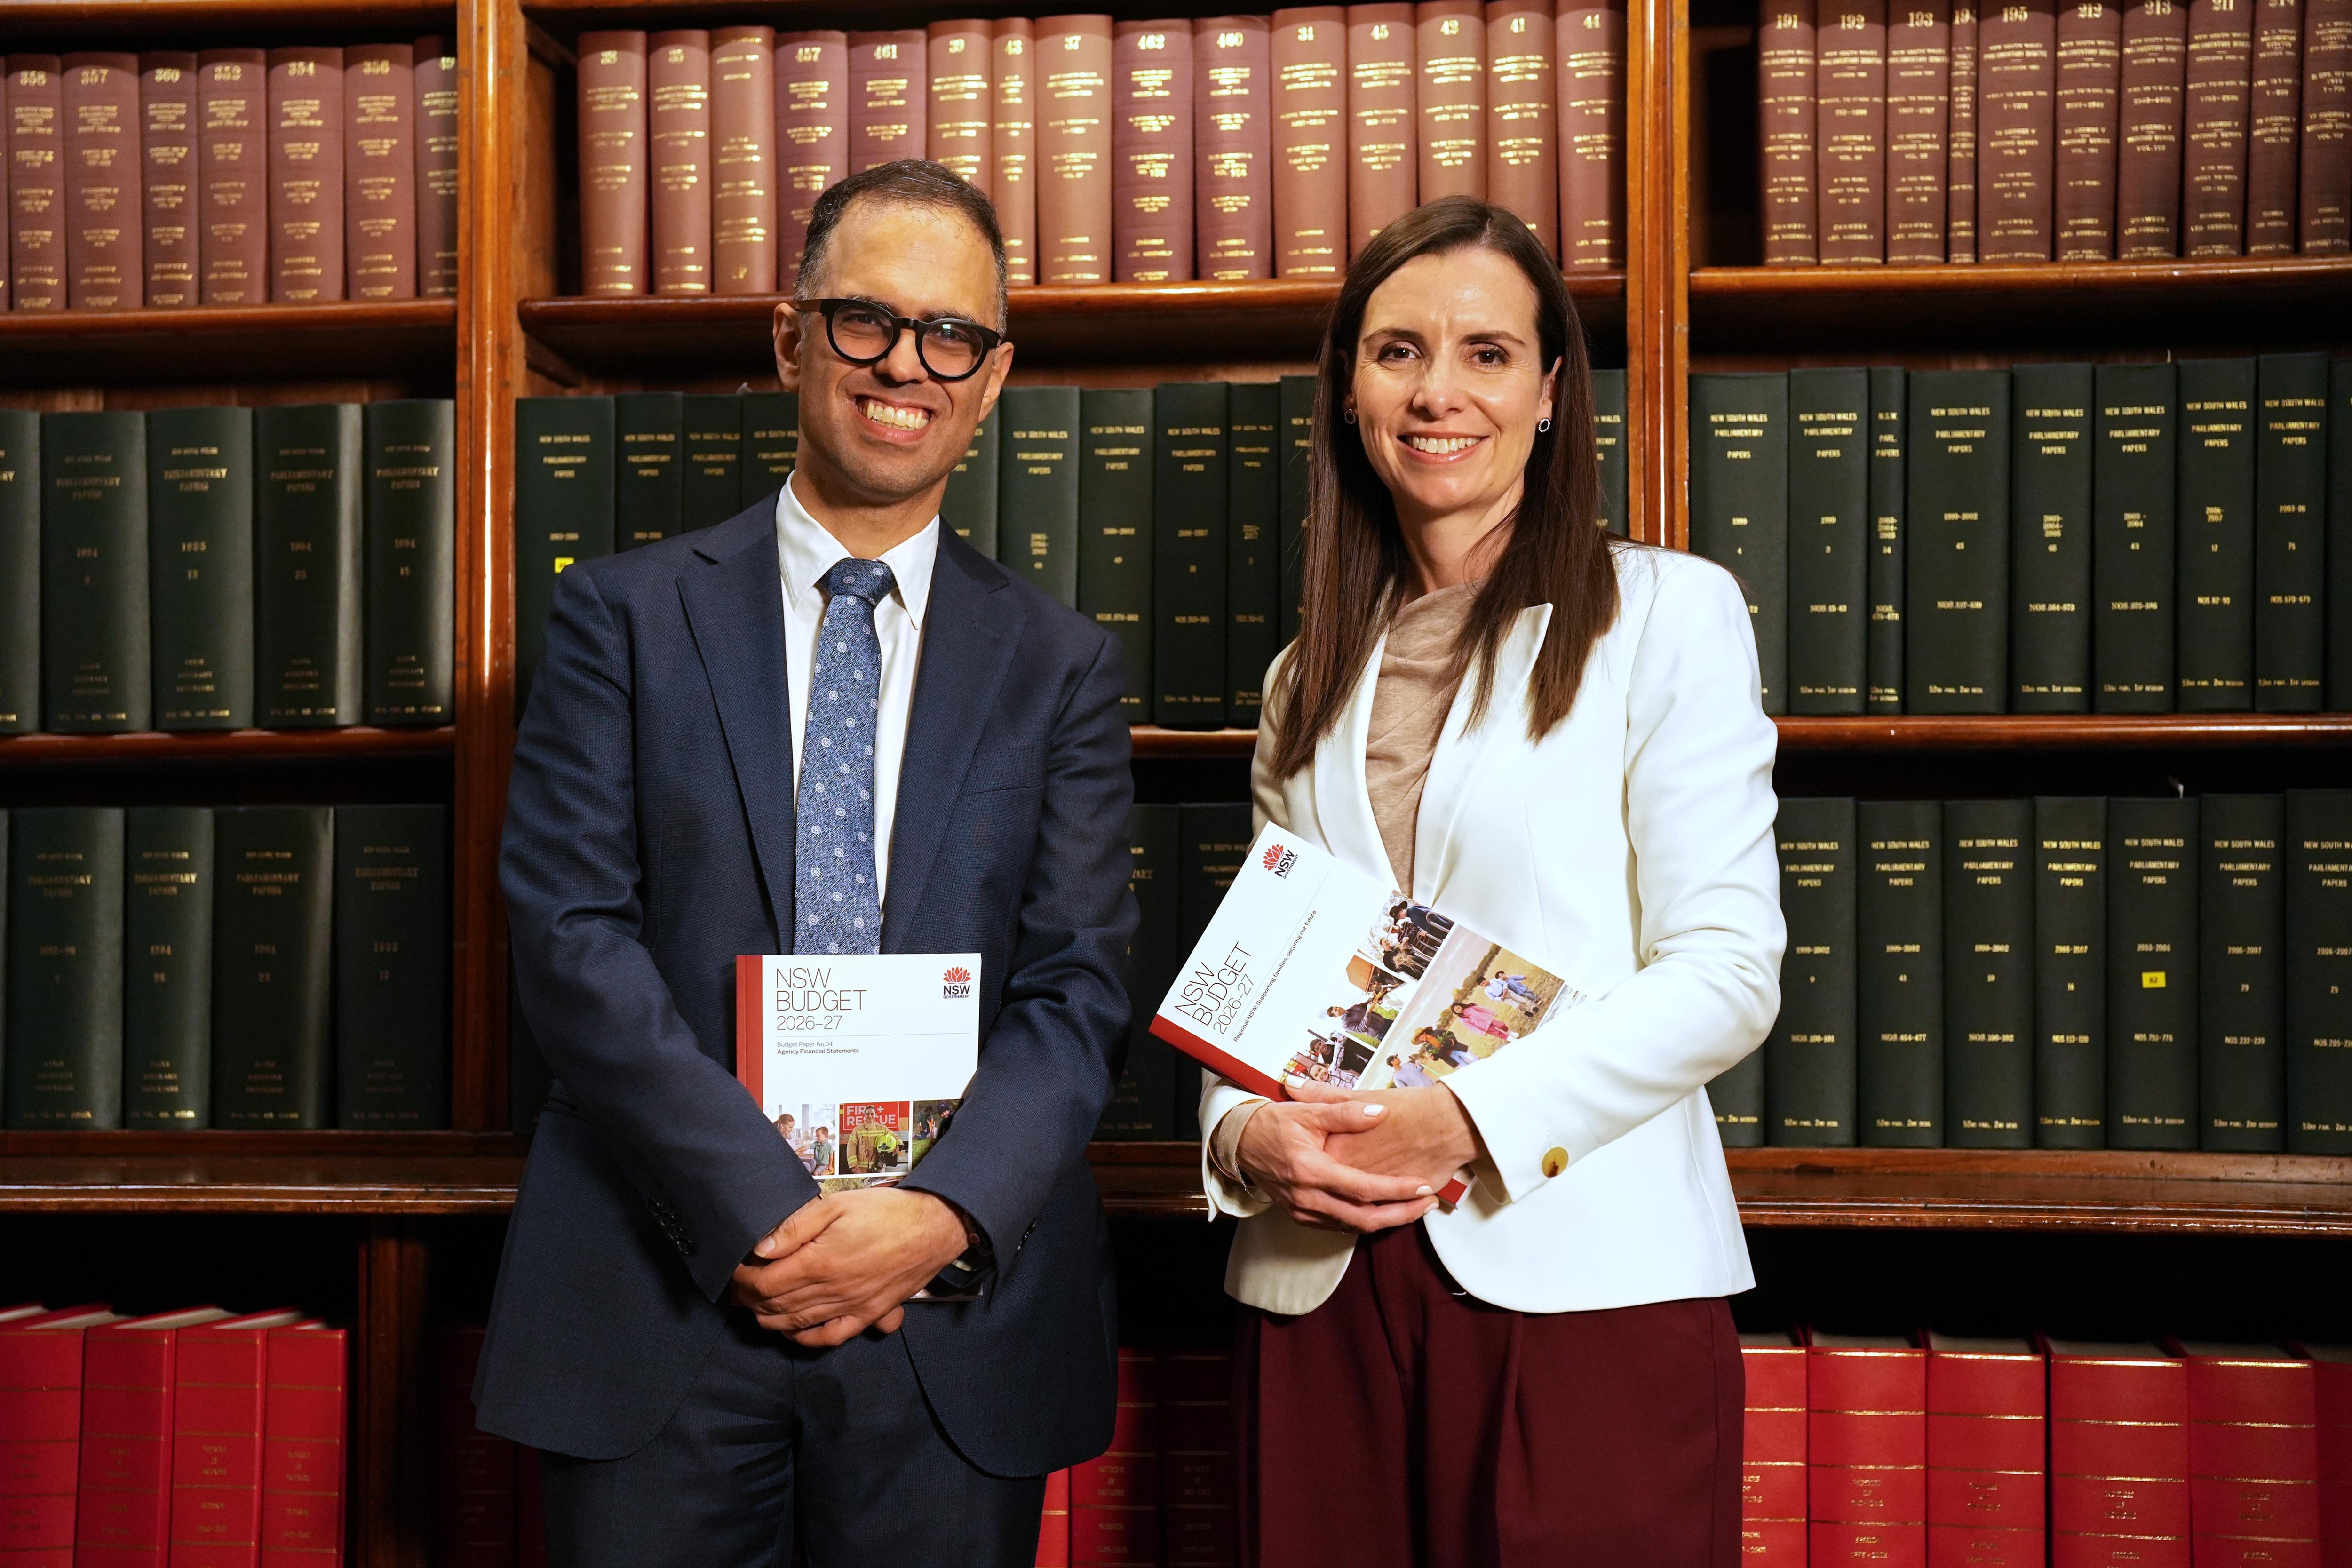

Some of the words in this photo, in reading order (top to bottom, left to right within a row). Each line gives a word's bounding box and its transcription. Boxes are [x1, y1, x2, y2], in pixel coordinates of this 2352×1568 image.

[2002, 7, 2028, 23] 195
[2077, 4, 2102, 19] 212
[1510, 17, 1525, 33] 41
[1583, 14, 1600, 29] 44
[1776, 15, 1798, 29] 191
[1841, 15, 1865, 30] 192
[1907, 13, 1933, 28] 193
[1298, 26, 1314, 41] 31
[1370, 24, 1389, 40] 45
[796, 47, 822, 62] 457
[874, 44, 898, 60] 461
[2203, 402, 2224, 410] SOUTH
[2225, 401, 2247, 409] WALES
[2192, 423, 2242, 432] PARLIAMENTARY
[2269, 421, 2320, 430] PARLIAMENTARY
[2204, 438, 2229, 447] PAPERS
[2282, 436, 2307, 445] PAPERS
[2141, 838, 2162, 847] SOUTH
[2163, 838, 2184, 847] WALES
[2231, 840, 2252, 849] SOUTH
[2254, 840, 2275, 848] WALES
[1274, 849, 1295, 877] NSW
[1283, 854, 1298, 879] GOVERNMENT
[2130, 861, 2179, 869] PARLIAMENTARY
[2219, 863, 2271, 871] PARLIAMENTARY
[2143, 876, 2167, 884] PAPERS
[2233, 878, 2257, 886] PAPERS
[2322, 879, 2347, 887] PAPERS
[776, 967, 832, 988] NSW
[1192, 941, 1251, 1026] BUDGET
[1233, 1019, 1249, 1043] Regional
[1246, 1005, 1259, 1020] NSW:
[1255, 977, 1277, 1006] Supporting
[1272, 957, 1289, 978] families,
[1286, 935, 1303, 957] securing
[1304, 910, 1317, 926] future
[943, 984, 971, 995] NSW
[1174, 962, 1215, 1016] NSW
[776, 989, 867, 1011] BUDGET
[846, 1114, 896, 1126] REUE
